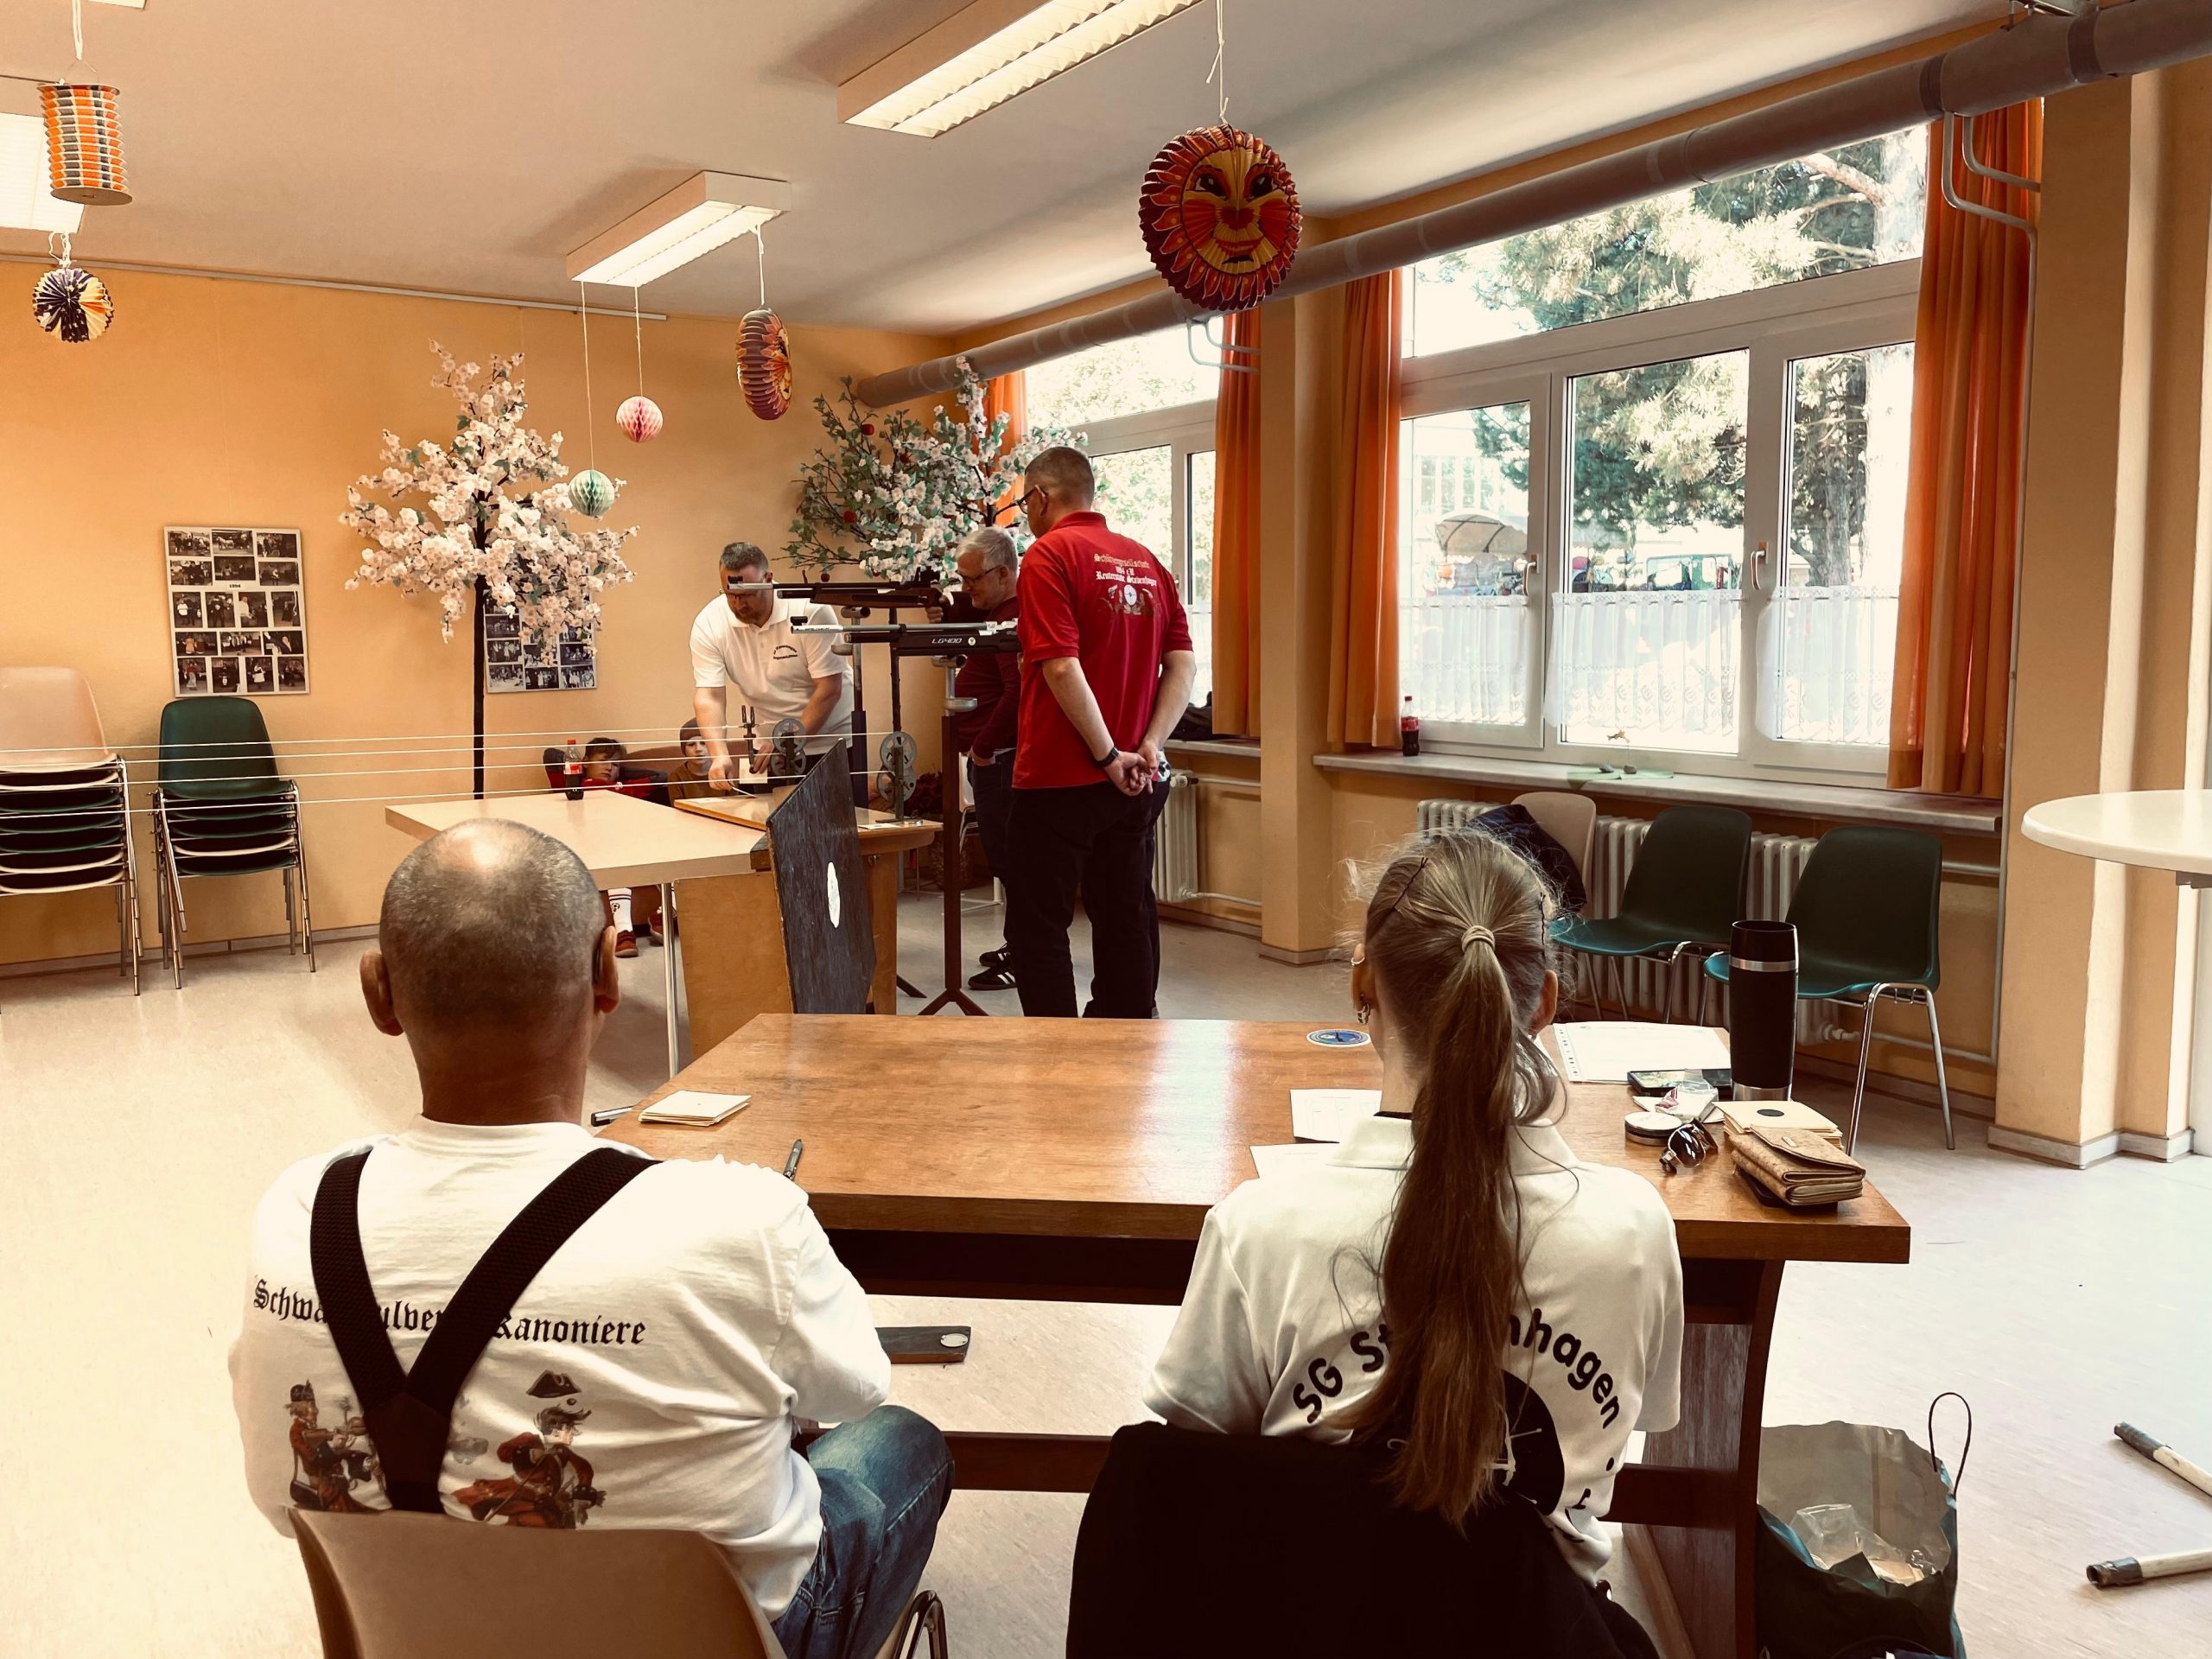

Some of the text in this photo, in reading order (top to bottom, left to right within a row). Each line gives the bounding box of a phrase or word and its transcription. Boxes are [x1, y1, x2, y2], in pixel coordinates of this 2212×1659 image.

[253, 1278, 444, 1332] Schwalve
[1292, 1307, 1620, 1430] SG Shagen
